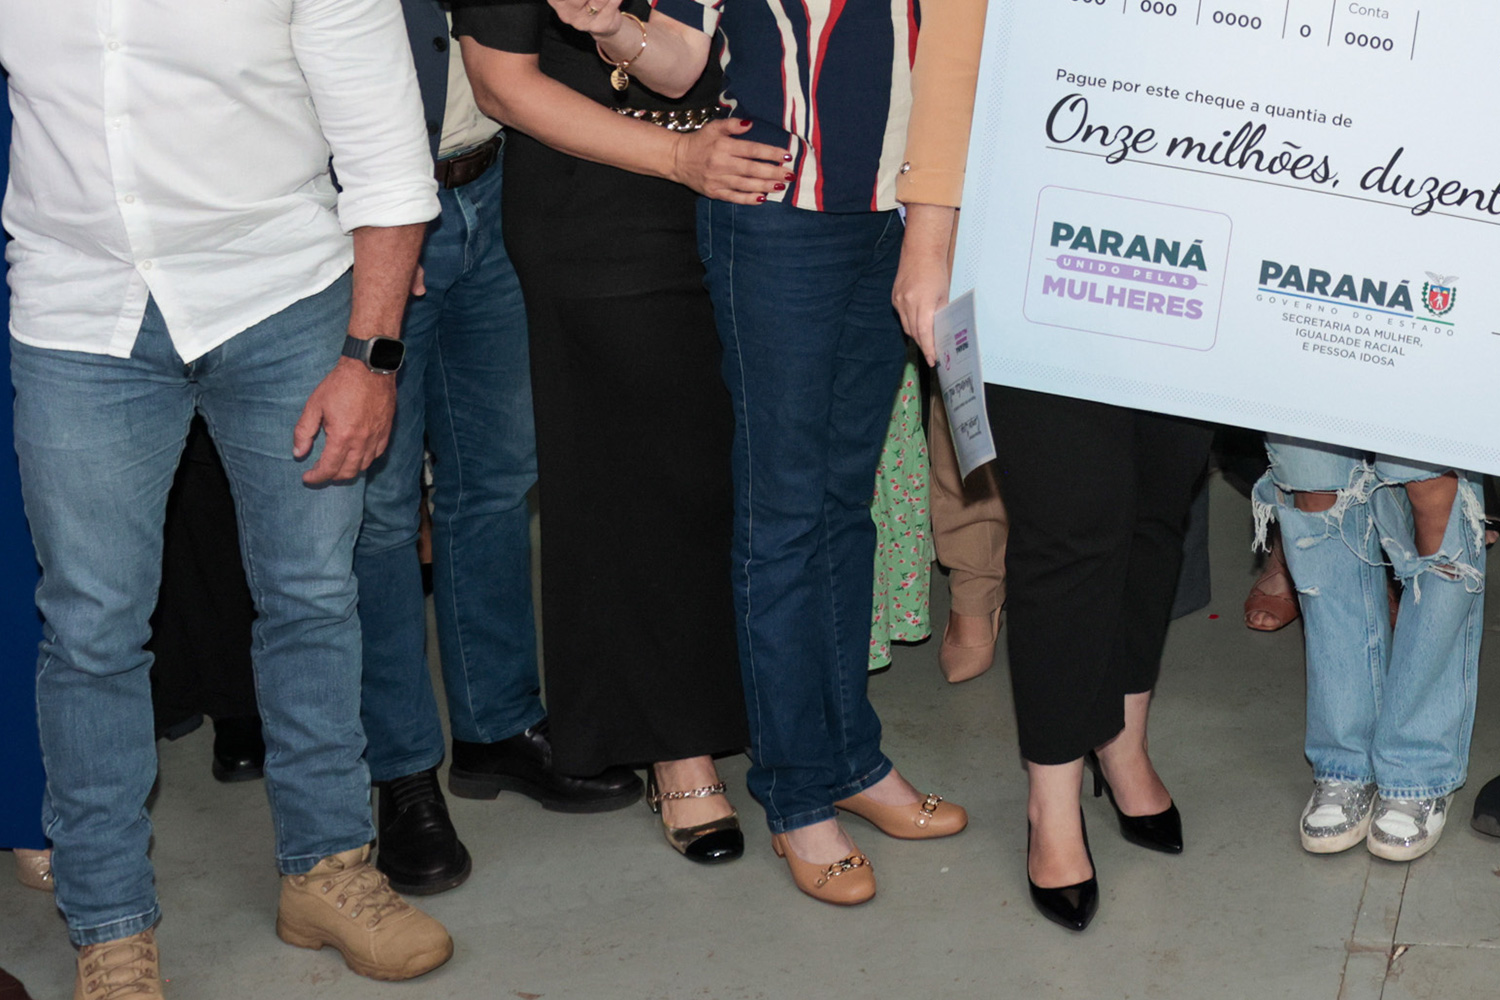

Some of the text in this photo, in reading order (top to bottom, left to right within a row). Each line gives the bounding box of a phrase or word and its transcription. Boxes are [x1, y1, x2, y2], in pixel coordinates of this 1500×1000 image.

[1140, 0, 1177, 17] 000
[1212, 10, 1262, 30] 0000
[1348, 1, 1390, 20] Conta
[1299, 23, 1312, 39] 0
[1343, 31, 1394, 53] 0000
[1056, 68, 1353, 129] Pague por este cheque a quantia de
[1045, 93, 1157, 165] Onze
[1166, 121, 1340, 188] milhões,
[1049, 220, 1207, 272] PARANÁ
[1062, 256, 1192, 287] UNIDO PELAS
[1258, 259, 1414, 312] PARANÁ
[1041, 274, 1204, 320] MULHERES
[1255, 293, 1455, 337] GOVERNO DO ESTADO
[1281, 312, 1424, 348] SECRETARIA DA MULHER,
[1295, 328, 1406, 357] IGUALDADE RACIAL
[1302, 342, 1395, 367] E PESSOA IDOSA
